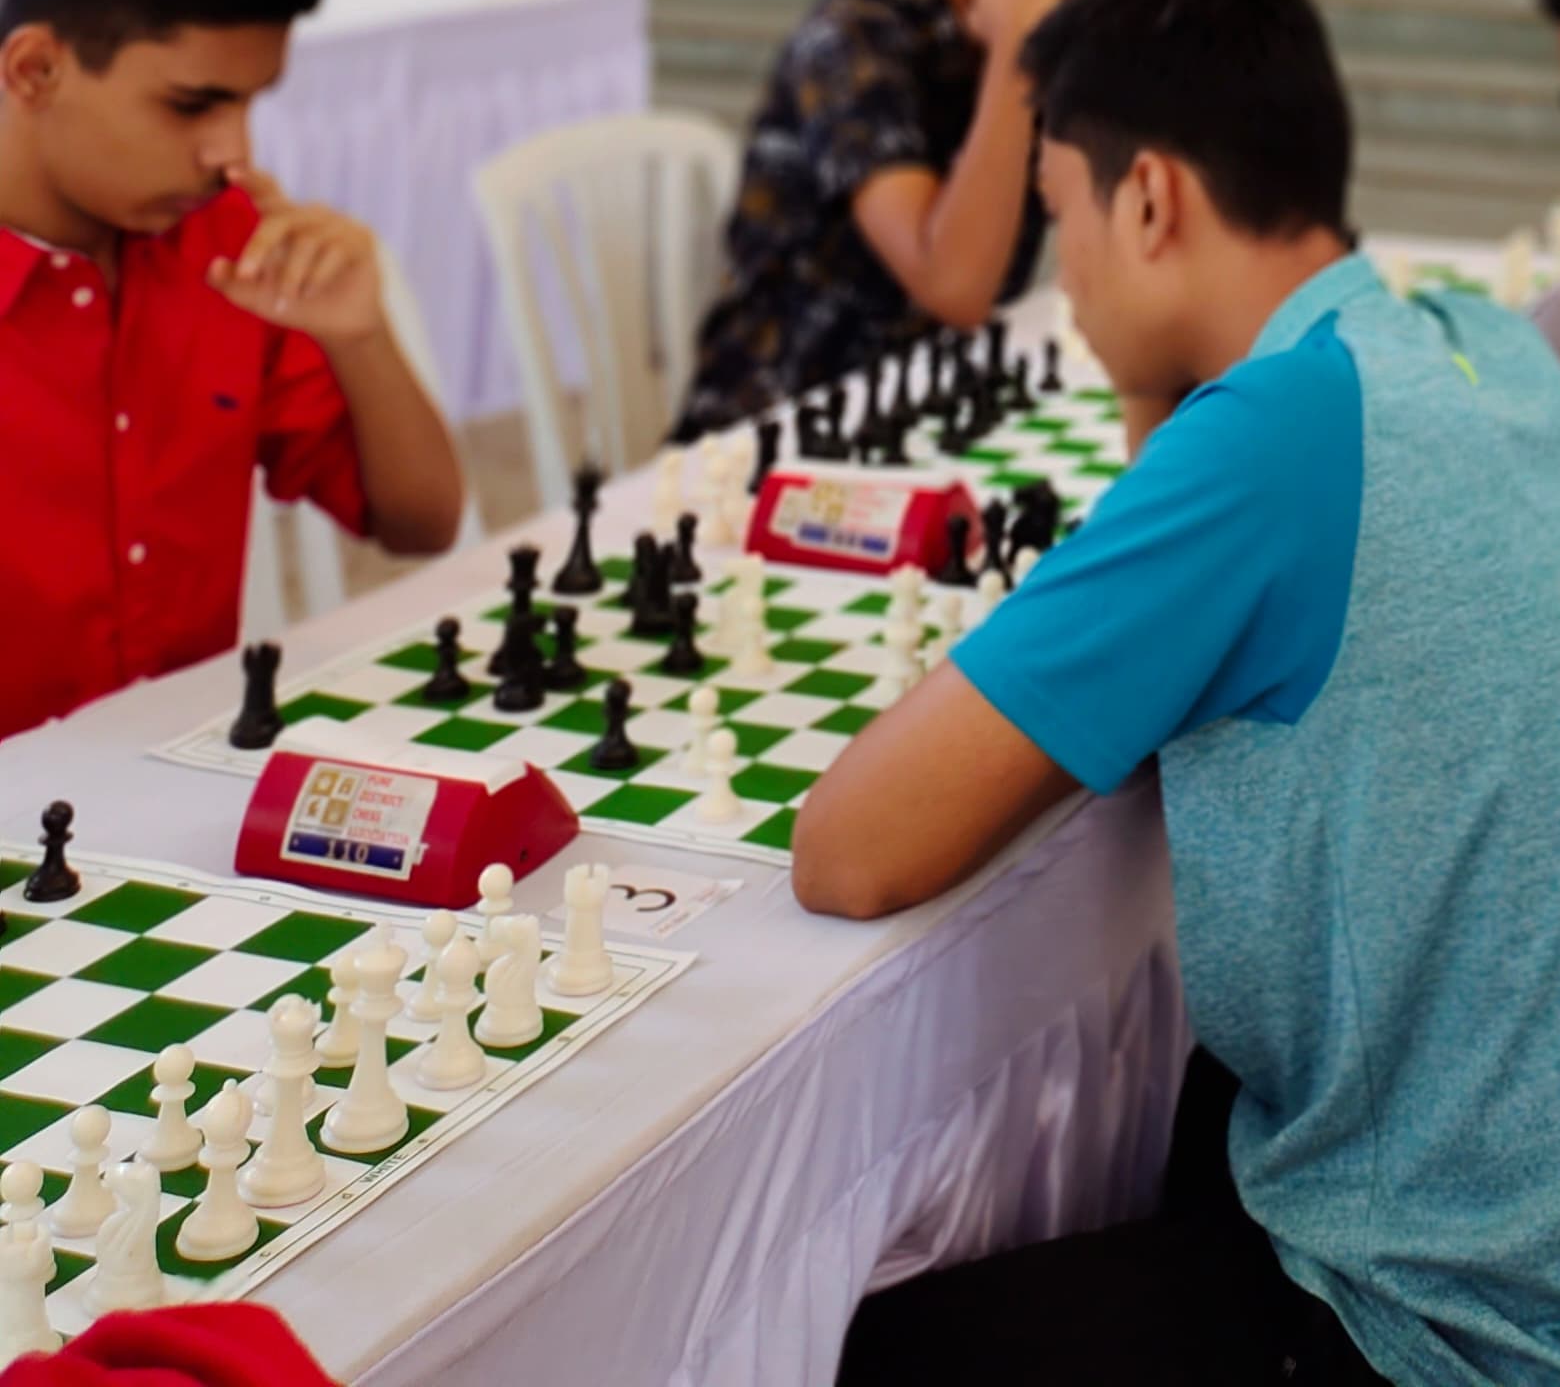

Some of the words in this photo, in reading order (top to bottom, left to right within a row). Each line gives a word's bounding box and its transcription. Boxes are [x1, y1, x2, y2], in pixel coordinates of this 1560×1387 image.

[327, 838, 369, 865] 110
[610, 883, 677, 913] 3
[359, 1153, 409, 1184] WHITE
